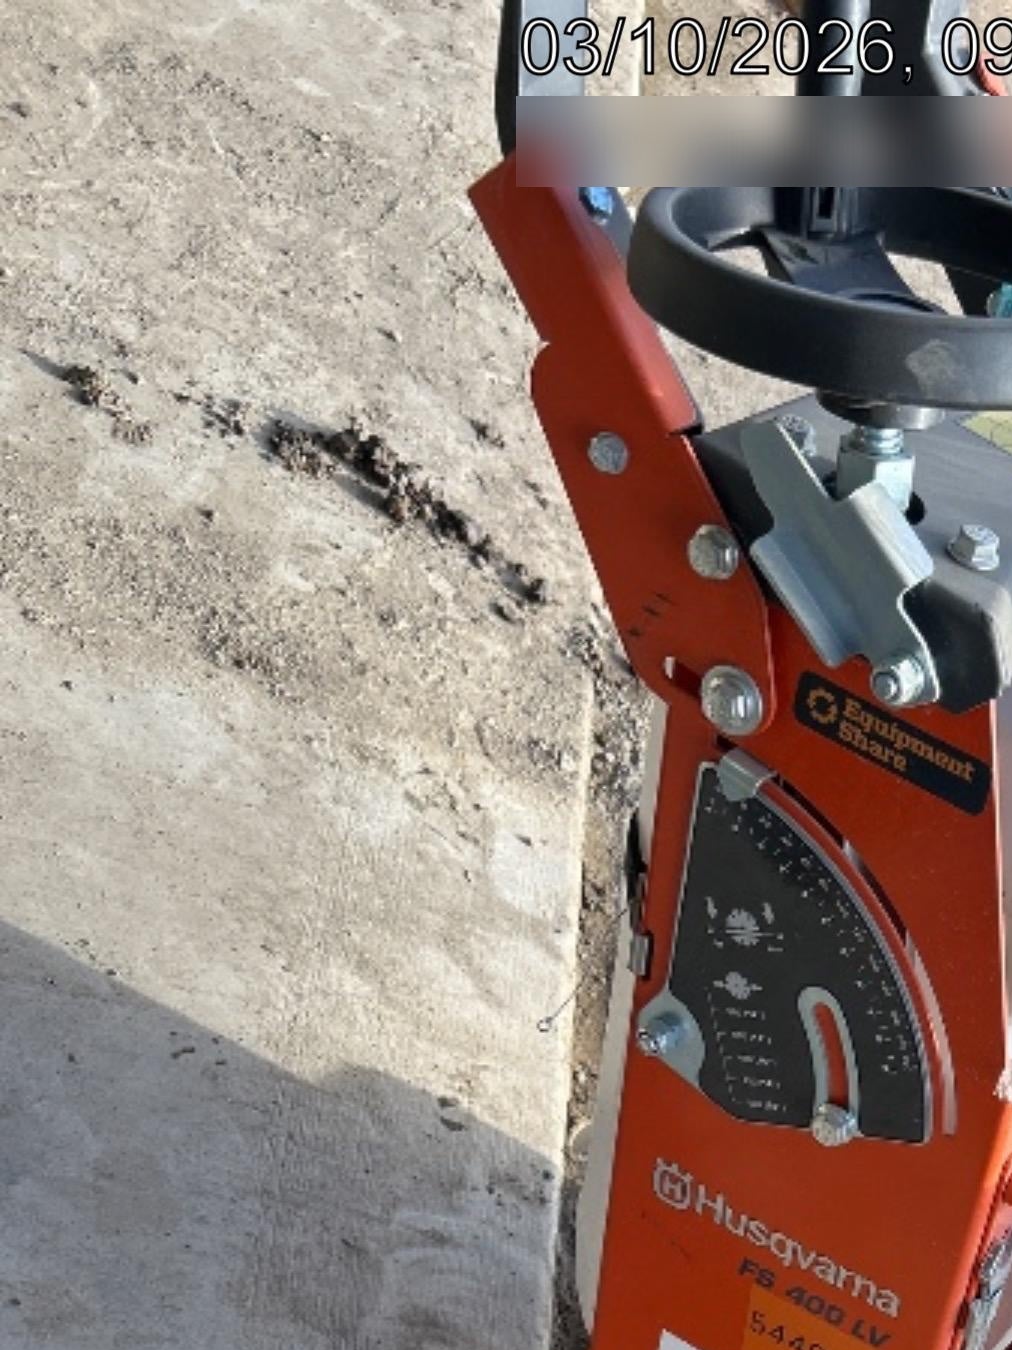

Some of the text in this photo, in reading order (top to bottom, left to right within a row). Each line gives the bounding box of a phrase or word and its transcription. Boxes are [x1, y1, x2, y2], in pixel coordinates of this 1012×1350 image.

[839, 718, 907, 772] Share
[842, 697, 976, 784] Equipment
[695, 1183, 900, 1318] Husqvarna
[738, 1258, 893, 1349] FS 400 LV
